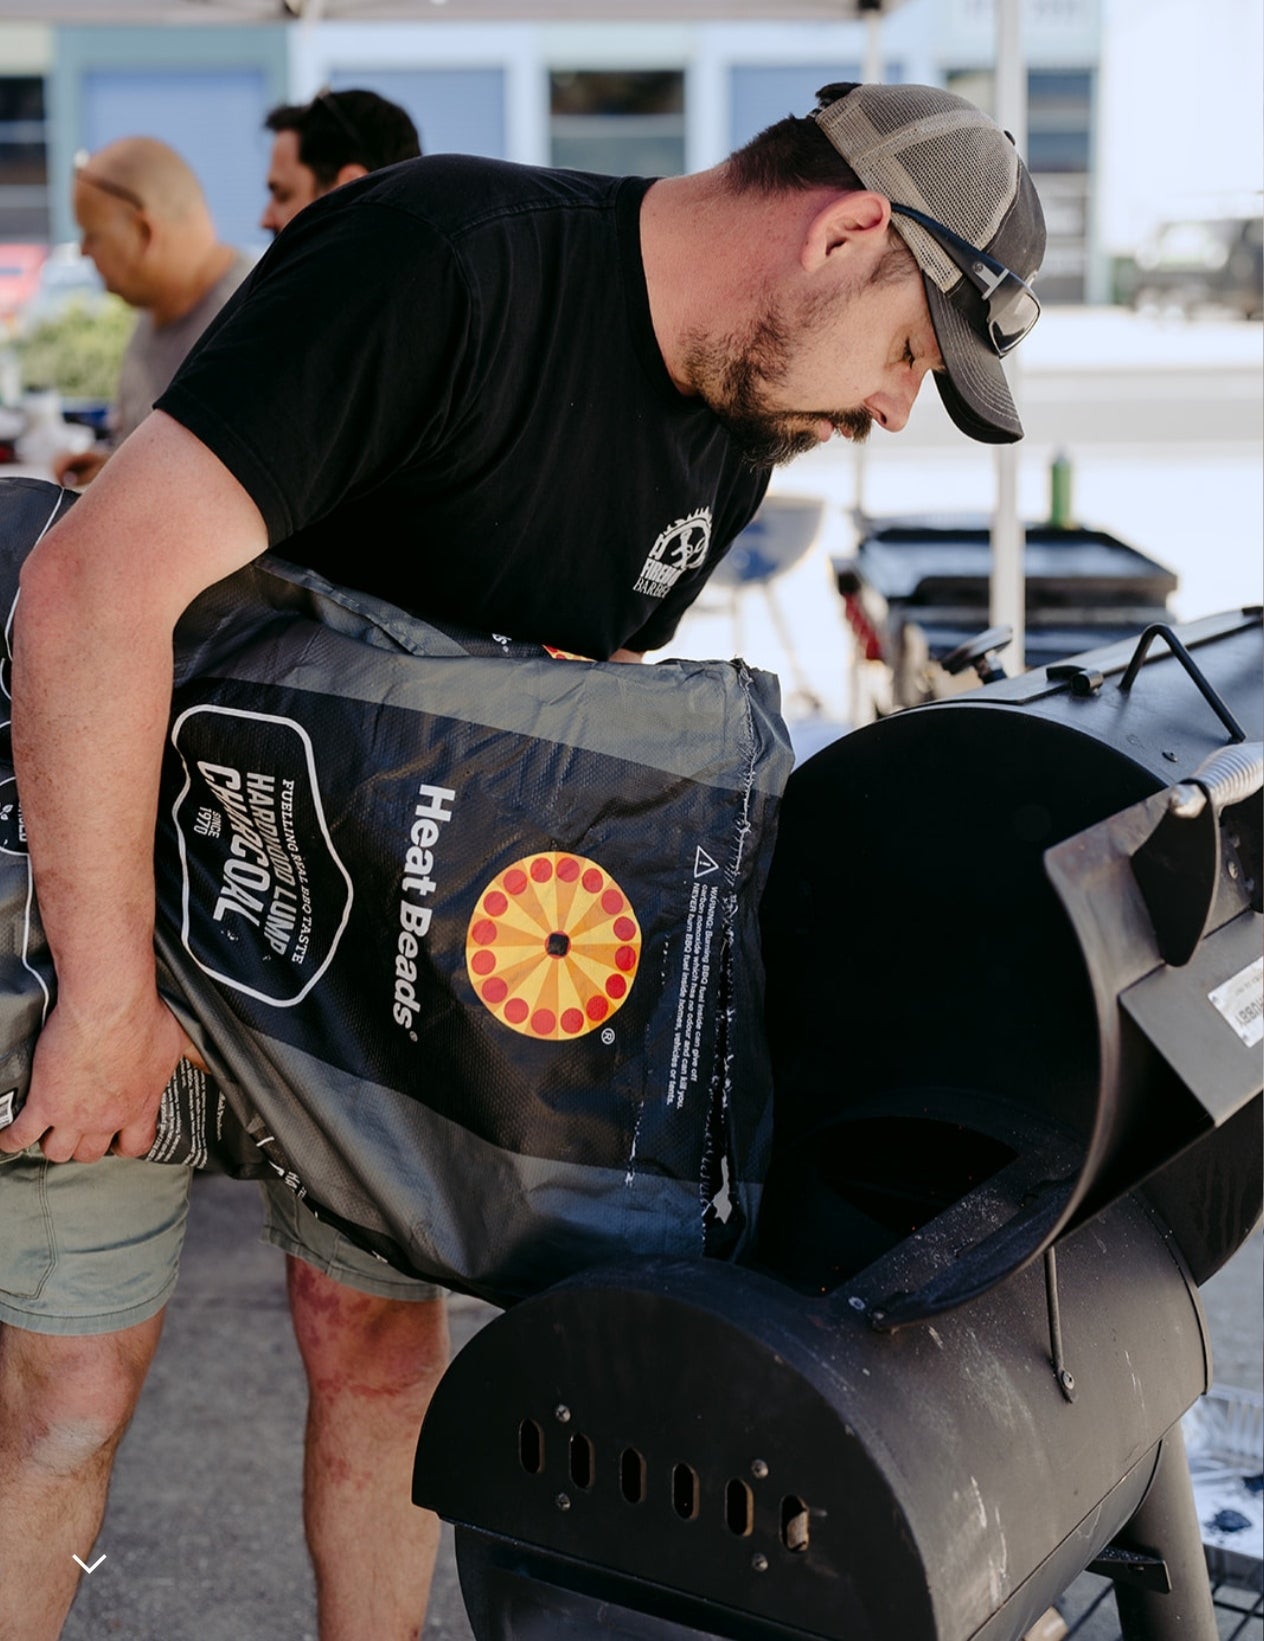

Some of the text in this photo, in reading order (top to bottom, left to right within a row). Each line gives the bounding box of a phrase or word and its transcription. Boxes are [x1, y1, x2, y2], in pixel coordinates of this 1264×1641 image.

[193, 806, 212, 835] 1970
[207, 810, 221, 838] SINCE
[197, 761, 271, 927] CHARCOAL
[402, 784, 456, 896] Heat
[247, 772, 297, 955] HARDWOOD LUMP
[281, 779, 312, 964] FUELLING REAL BBQ TASTE
[698, 884, 708, 914] carbon
[706, 886, 719, 929] WARNING:
[694, 915, 703, 955] monoxide
[702, 930, 713, 963] Burning
[692, 956, 700, 981] which
[700, 964, 710, 984] BBQ
[666, 883, 700, 1105] NEVER burn BBQ fuel inside homes, vehicles or tents.
[689, 982, 698, 999] has
[698, 986, 707, 1003] fuel
[688, 1000, 694, 1011] no
[696, 1003, 705, 1029] inside
[685, 1013, 694, 1039] odour
[683, 1040, 691, 1057] and
[692, 1048, 700, 1067] give
[679, 1076, 688, 1090] kill
[690, 1068, 698, 1082] off
[676, 1090, 685, 1109] you.
